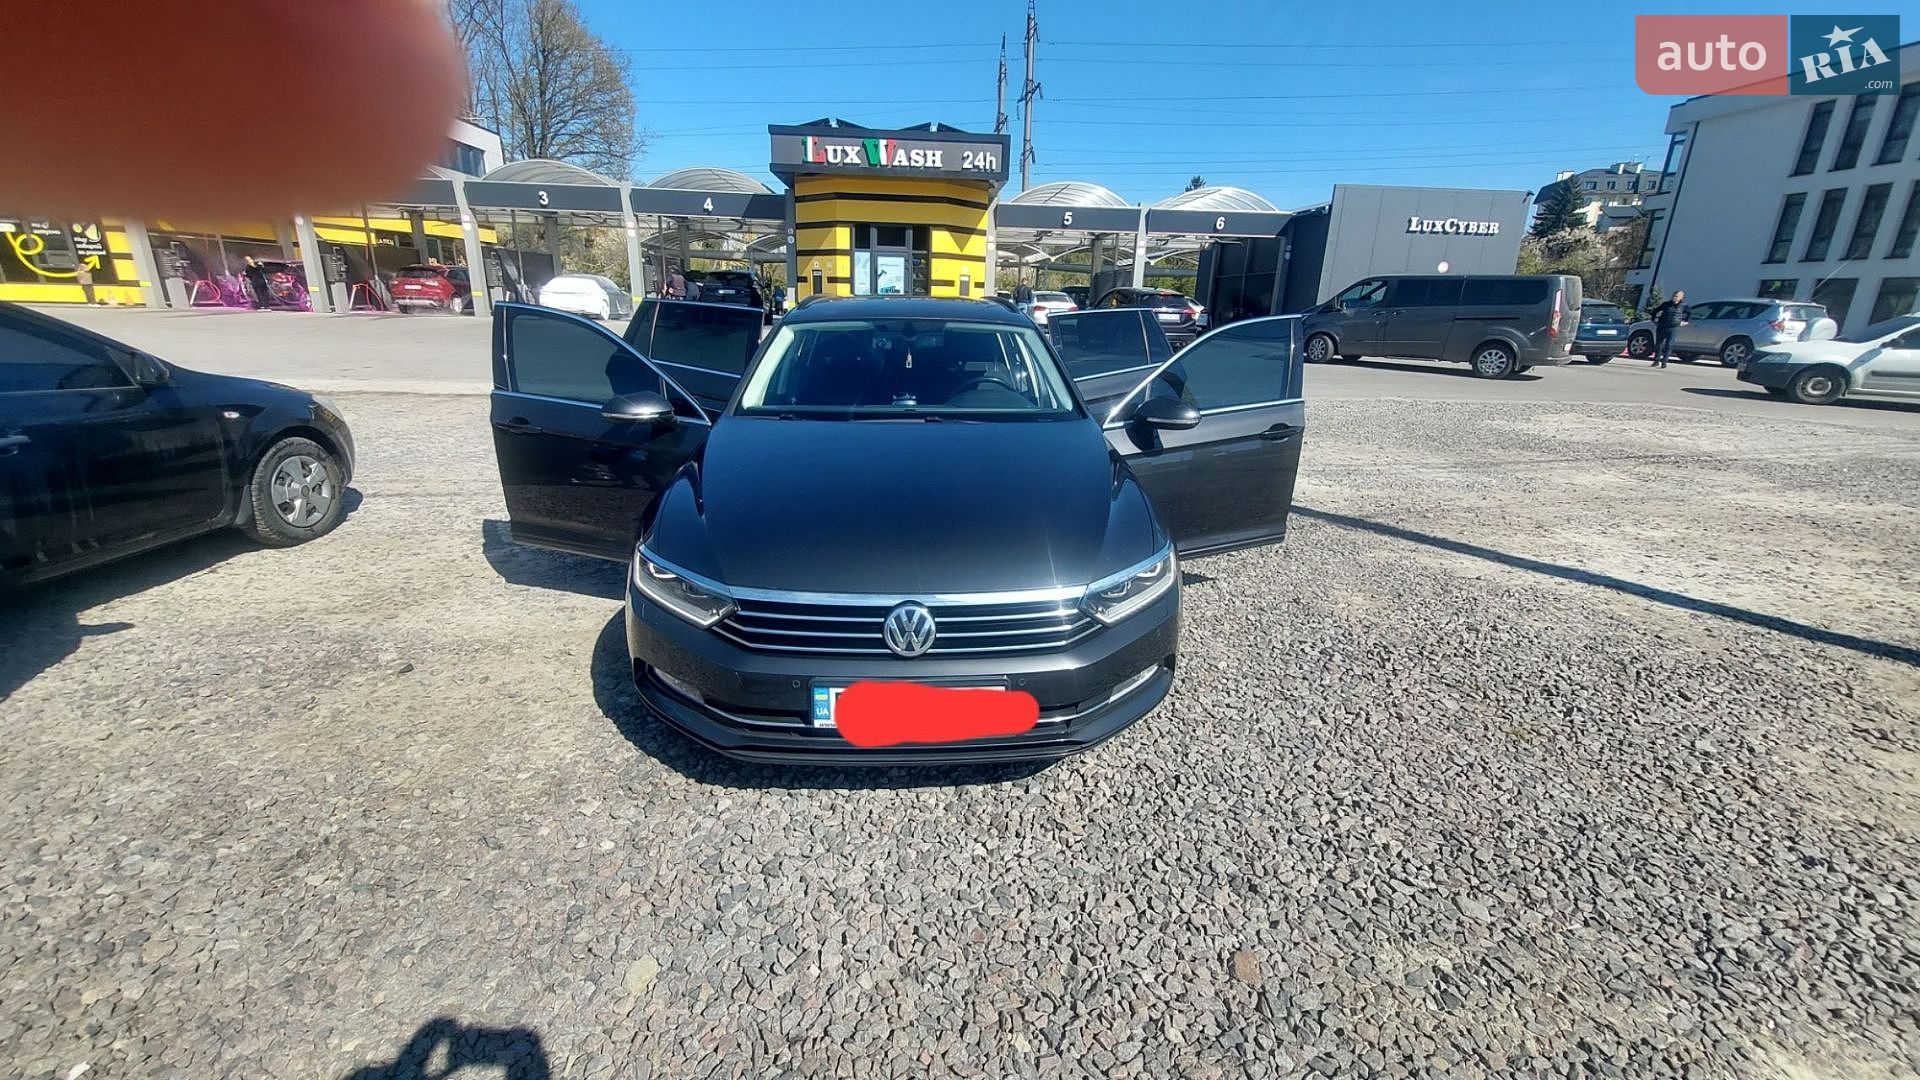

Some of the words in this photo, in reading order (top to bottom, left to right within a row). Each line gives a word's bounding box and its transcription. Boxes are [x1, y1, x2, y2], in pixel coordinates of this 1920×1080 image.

[962, 150, 997, 170] 24h
[538, 190, 549, 206] 3
[703, 196, 714, 212] 4
[1063, 211, 1073, 226] 5
[1216, 216, 1226, 230] 6
[816, 707, 830, 716] UA
